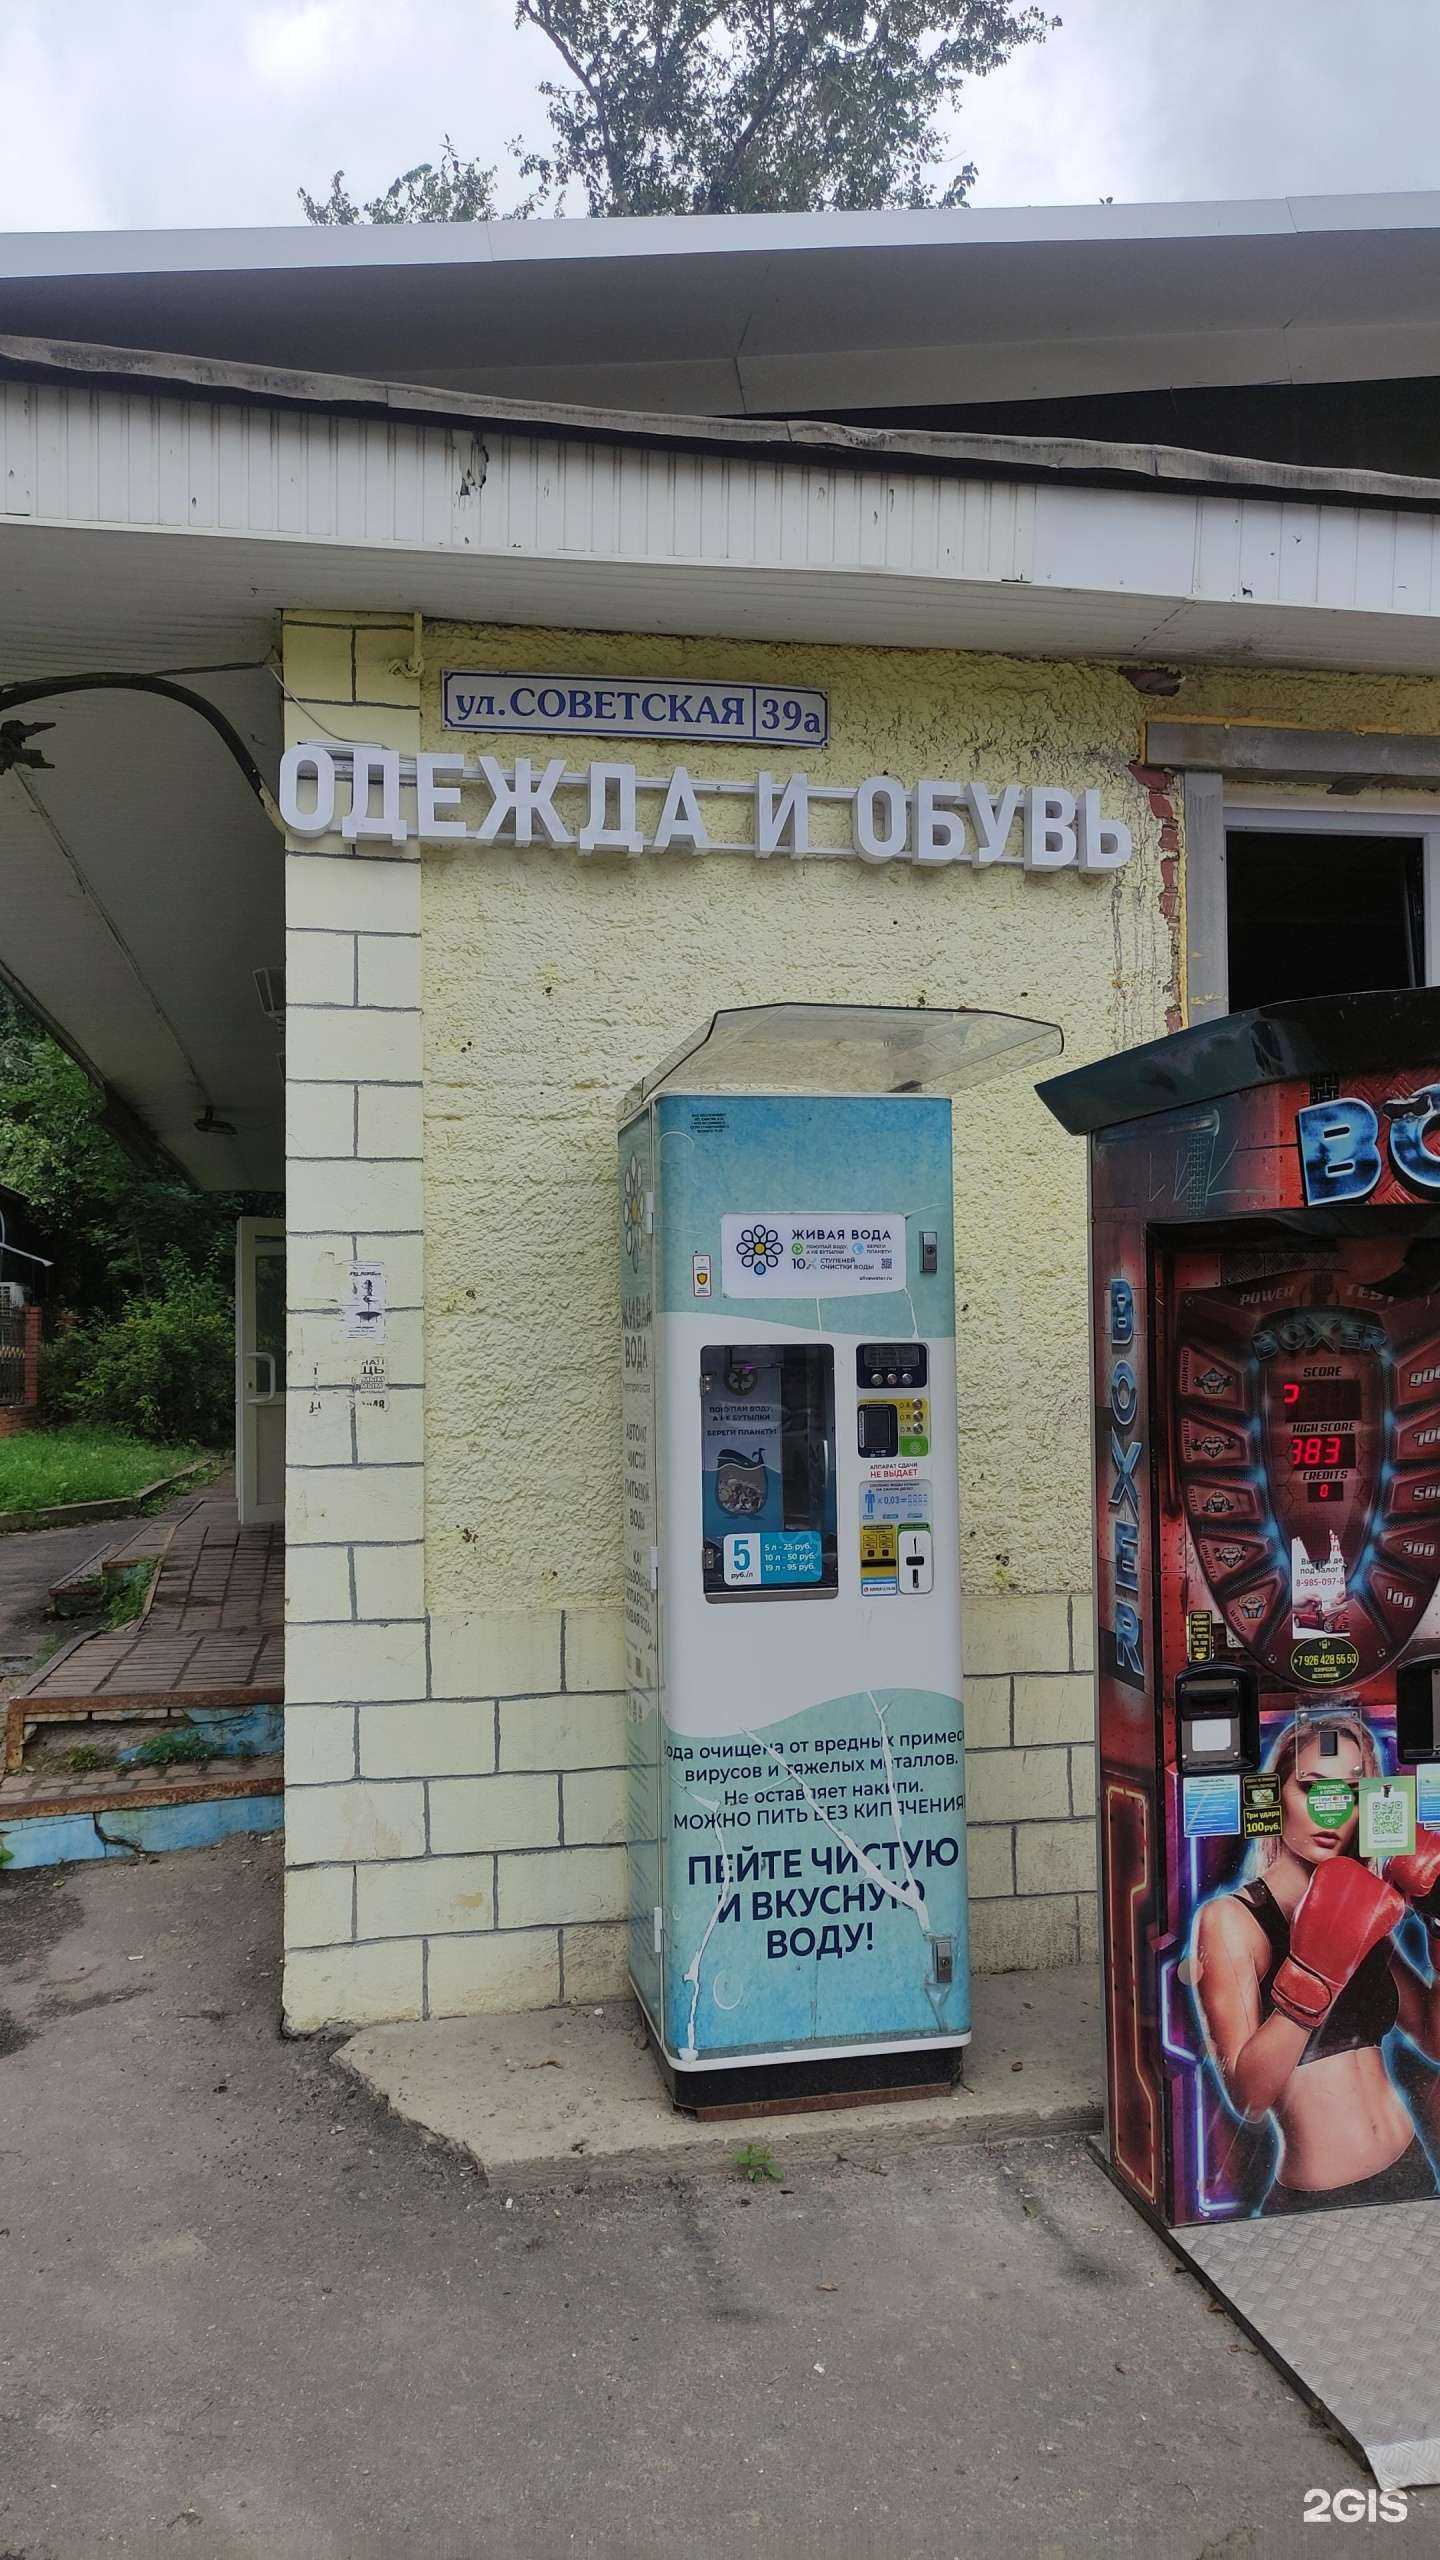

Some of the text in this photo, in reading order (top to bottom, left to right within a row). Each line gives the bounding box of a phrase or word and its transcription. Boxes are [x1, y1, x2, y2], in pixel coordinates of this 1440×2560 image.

[761, 698, 821, 733] 39а
[278, 743, 1133, 874] ОДЕЖДА И ОБУВЬ
[792, 1229, 892, 1242] ЖИВАЯ ВОДА
[792, 1258, 806, 1270] 10
[1303, 1366, 1343, 1377] SCORE
[1292, 1423, 1355, 1433] HIGH SCORE
[1413, 1427, 1440, 1447] 70
[870, 1469, 918, 1478] НЕ ВЫДАЕТ
[1303, 1470, 1348, 1481] CREDITS
[1413, 1485, 1440, 1501] 50
[734, 1540, 750, 1571] 5
[784, 1543, 793, 1551] 25
[1402, 1541, 1435, 1557] 300
[1386, 1587, 1414, 1609] 100
[1304, 1655, 1319, 1666] 926
[1320, 1653, 1335, 1665] 428
[1336, 1653, 1346, 1664] 55
[1347, 1653, 1357, 1664] 53
[789, 1741, 809, 1754] от
[815, 1734, 894, 1755] вредных
[685, 1766, 762, 1785] вирусов
[768, 1764, 779, 1777] и
[787, 1759, 865, 1776] тяжелых
[724, 1790, 749, 1806] Не
[674, 1811, 751, 1830] МОЖНО
[757, 1807, 808, 1826] ПИТЬ
[688, 1837, 959, 1885] ПЕЙТЕ ЧИСТУЮ
[717, 1893, 741, 1923] И
[767, 1922, 874, 1961] ВОДУ!
